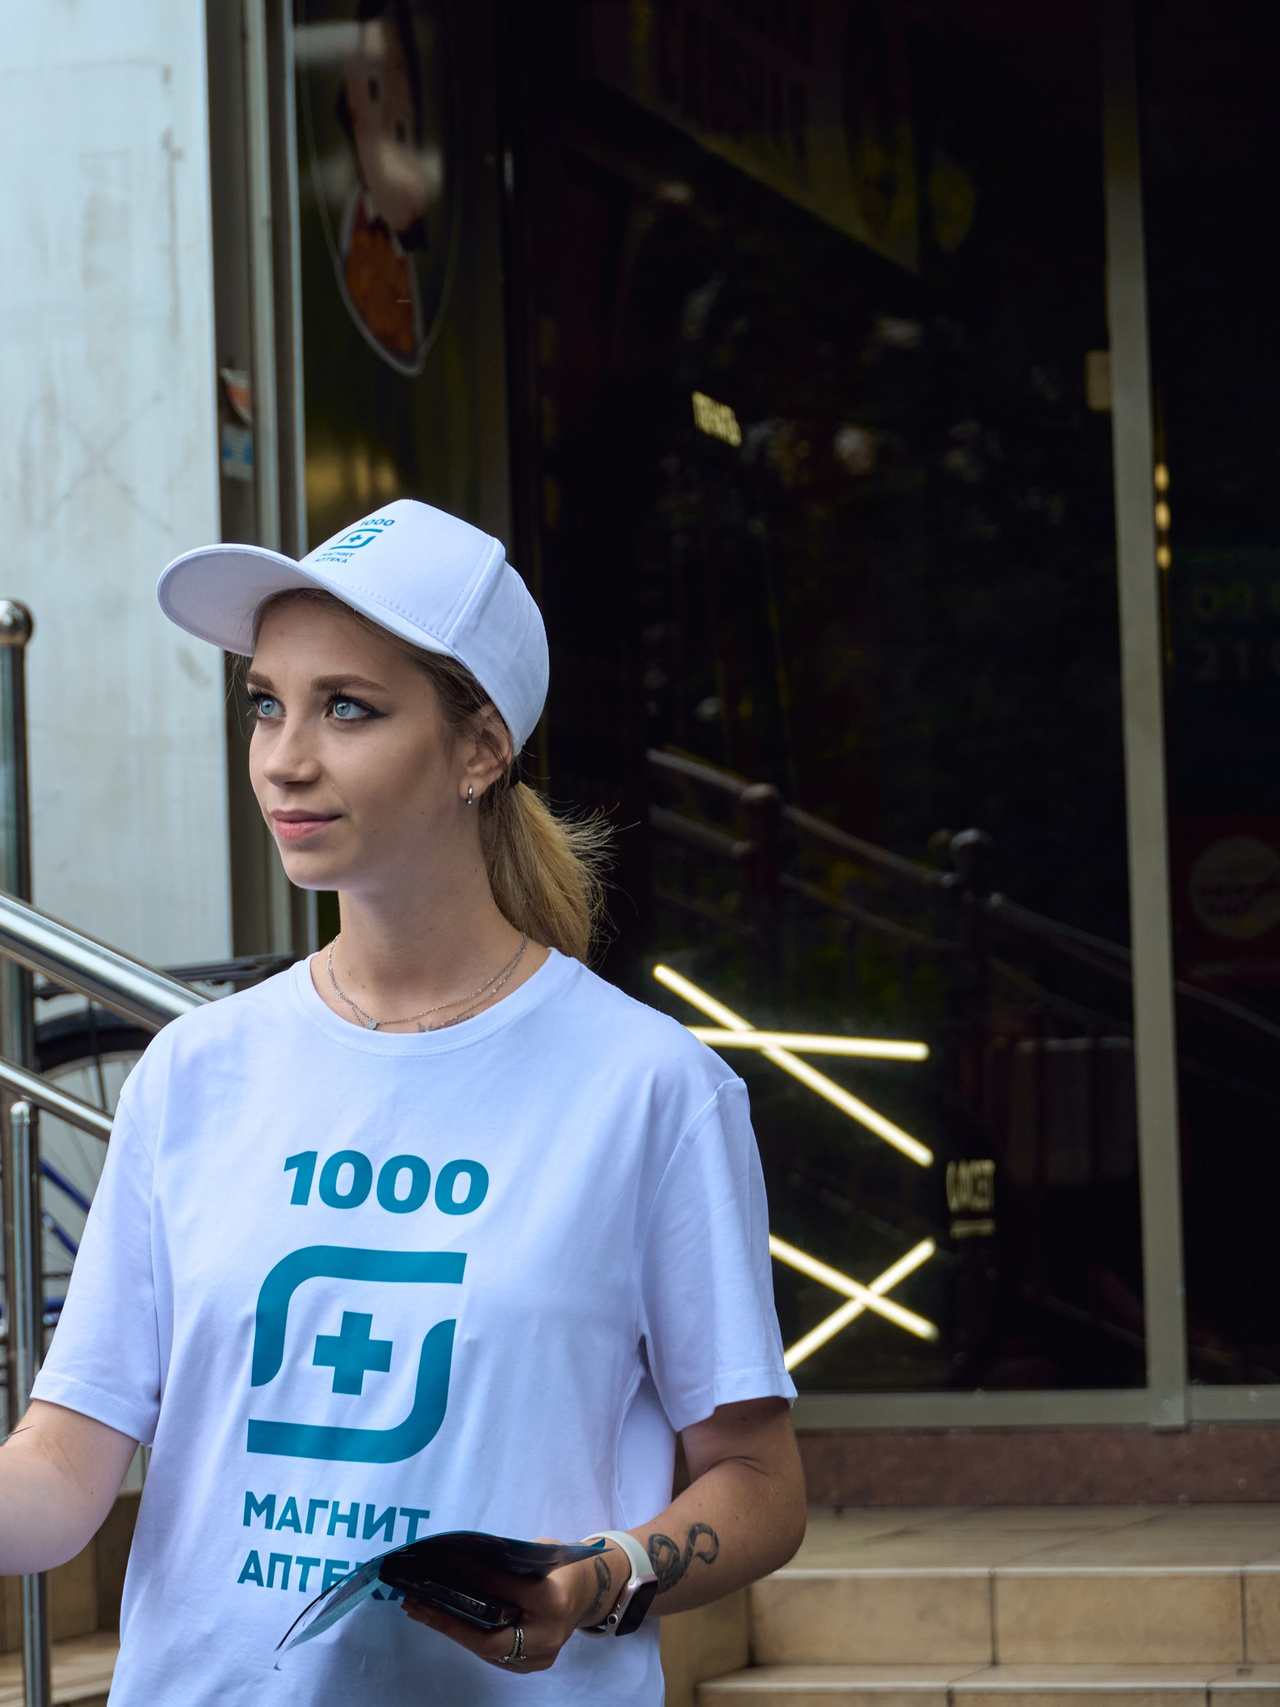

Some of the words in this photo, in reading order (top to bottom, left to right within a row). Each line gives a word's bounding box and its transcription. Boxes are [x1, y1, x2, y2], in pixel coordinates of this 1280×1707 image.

[360, 518, 395, 527] 1000
[283, 1150, 489, 1215] 1000
[243, 1491, 430, 1543] МАГНИТ
[237, 1549, 406, 1600] АПТЕ
